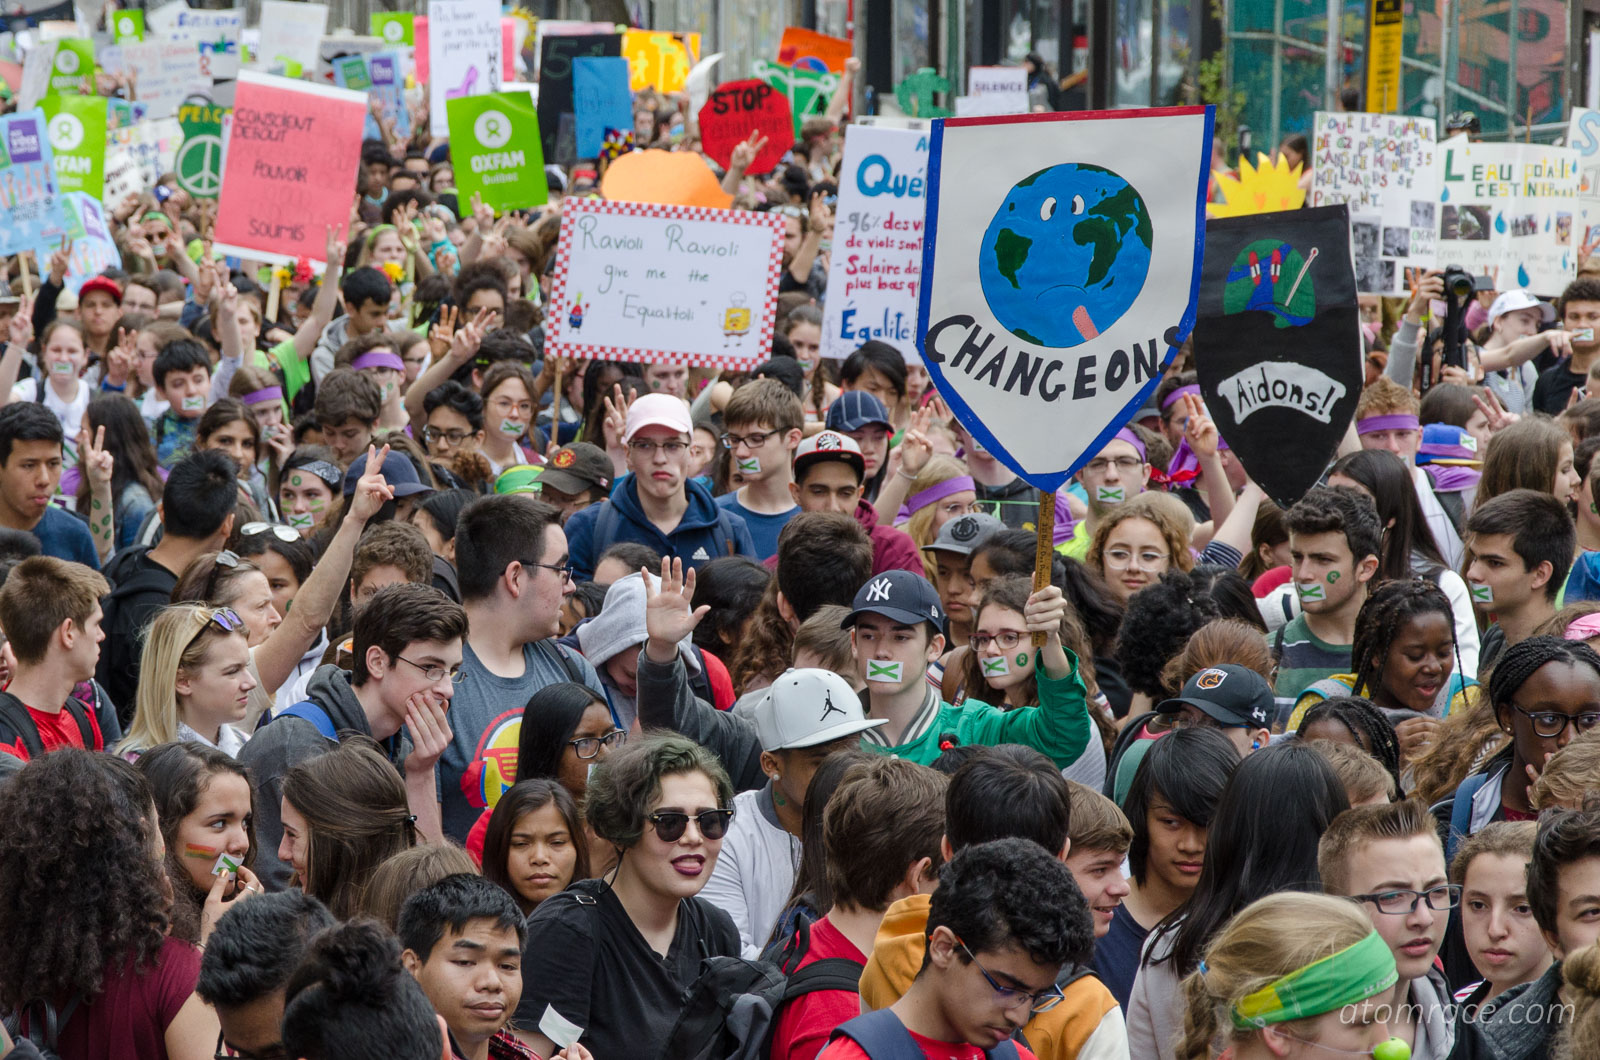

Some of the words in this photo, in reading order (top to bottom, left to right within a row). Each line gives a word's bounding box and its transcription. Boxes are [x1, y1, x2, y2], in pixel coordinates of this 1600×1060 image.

[713, 83, 771, 115] STOP
[470, 149, 526, 174] OXFAM
[856, 153, 926, 198] Qué
[578, 214, 643, 250] Ravioli
[665, 223, 739, 257] Ravioli
[598, 264, 629, 294] give
[646, 268, 667, 279] me
[688, 268, 709, 282] the
[845, 254, 901, 275] Salaire
[846, 277, 872, 297] plus
[1236, 366, 1336, 415] Aidons!
[866, 577, 893, 602] NY
